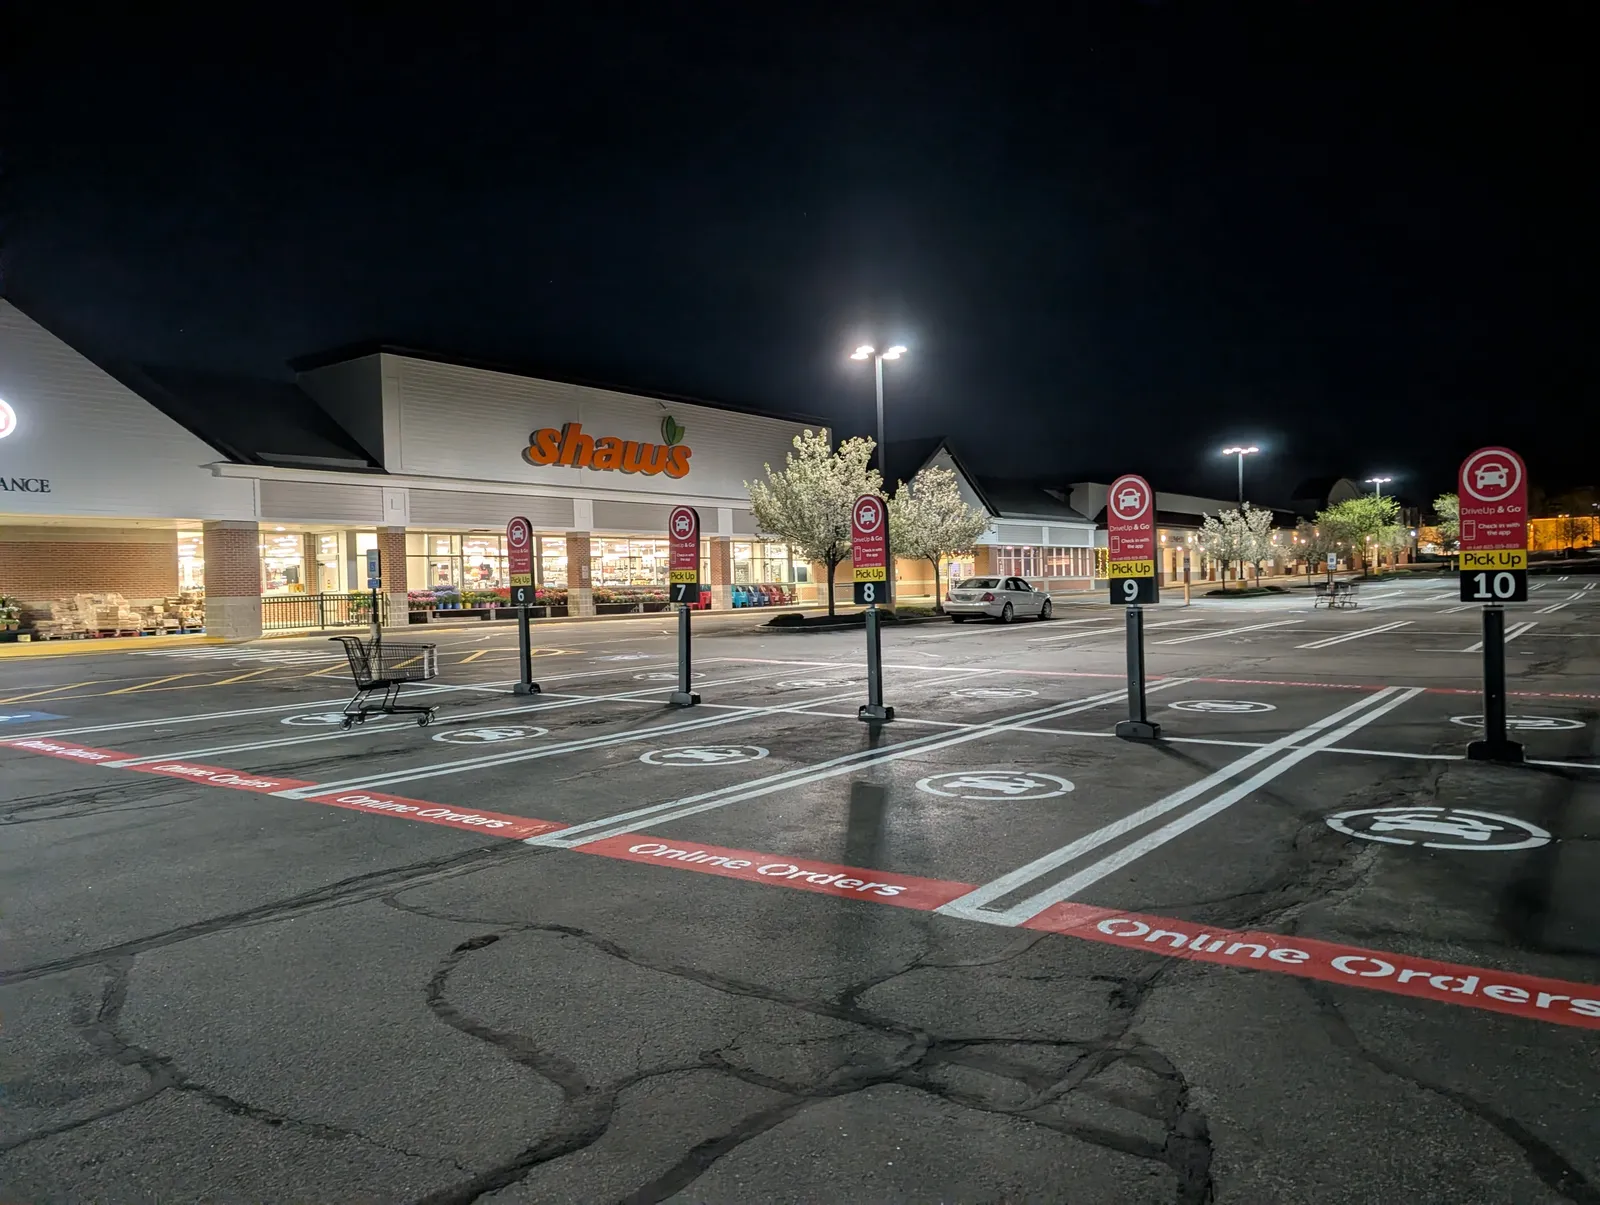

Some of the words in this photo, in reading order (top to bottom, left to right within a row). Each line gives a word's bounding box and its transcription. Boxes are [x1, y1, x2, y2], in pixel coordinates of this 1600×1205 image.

[1461, 507, 1496, 515] DriveUp
[1497, 505, 1505, 513] &
[1506, 505, 1521, 513] Go
[1464, 553, 1496, 565] Pick
[1499, 552, 1522, 567] Up
[670, 572, 685, 580] Pick
[685, 571, 695, 581] Up
[855, 569, 871, 578] Pick
[872, 569, 884, 580] Up
[1112, 563, 1133, 574] Pick
[1135, 563, 1151, 575] Up
[522, 576, 530, 584] Up
[1473, 572, 1516, 599] 10
[517, 588, 525, 602] 6
[676, 584, 687, 601] 7
[863, 583, 875, 602] 8
[1123, 579, 1139, 602] 9
[336, 795, 420, 813] Online
[416, 808, 513, 828] Orders
[628, 843, 752, 870] Online
[757, 863, 908, 897] Orders
[1096, 918, 1311, 964] Online
[1330, 955, 1600, 1017] Orders
